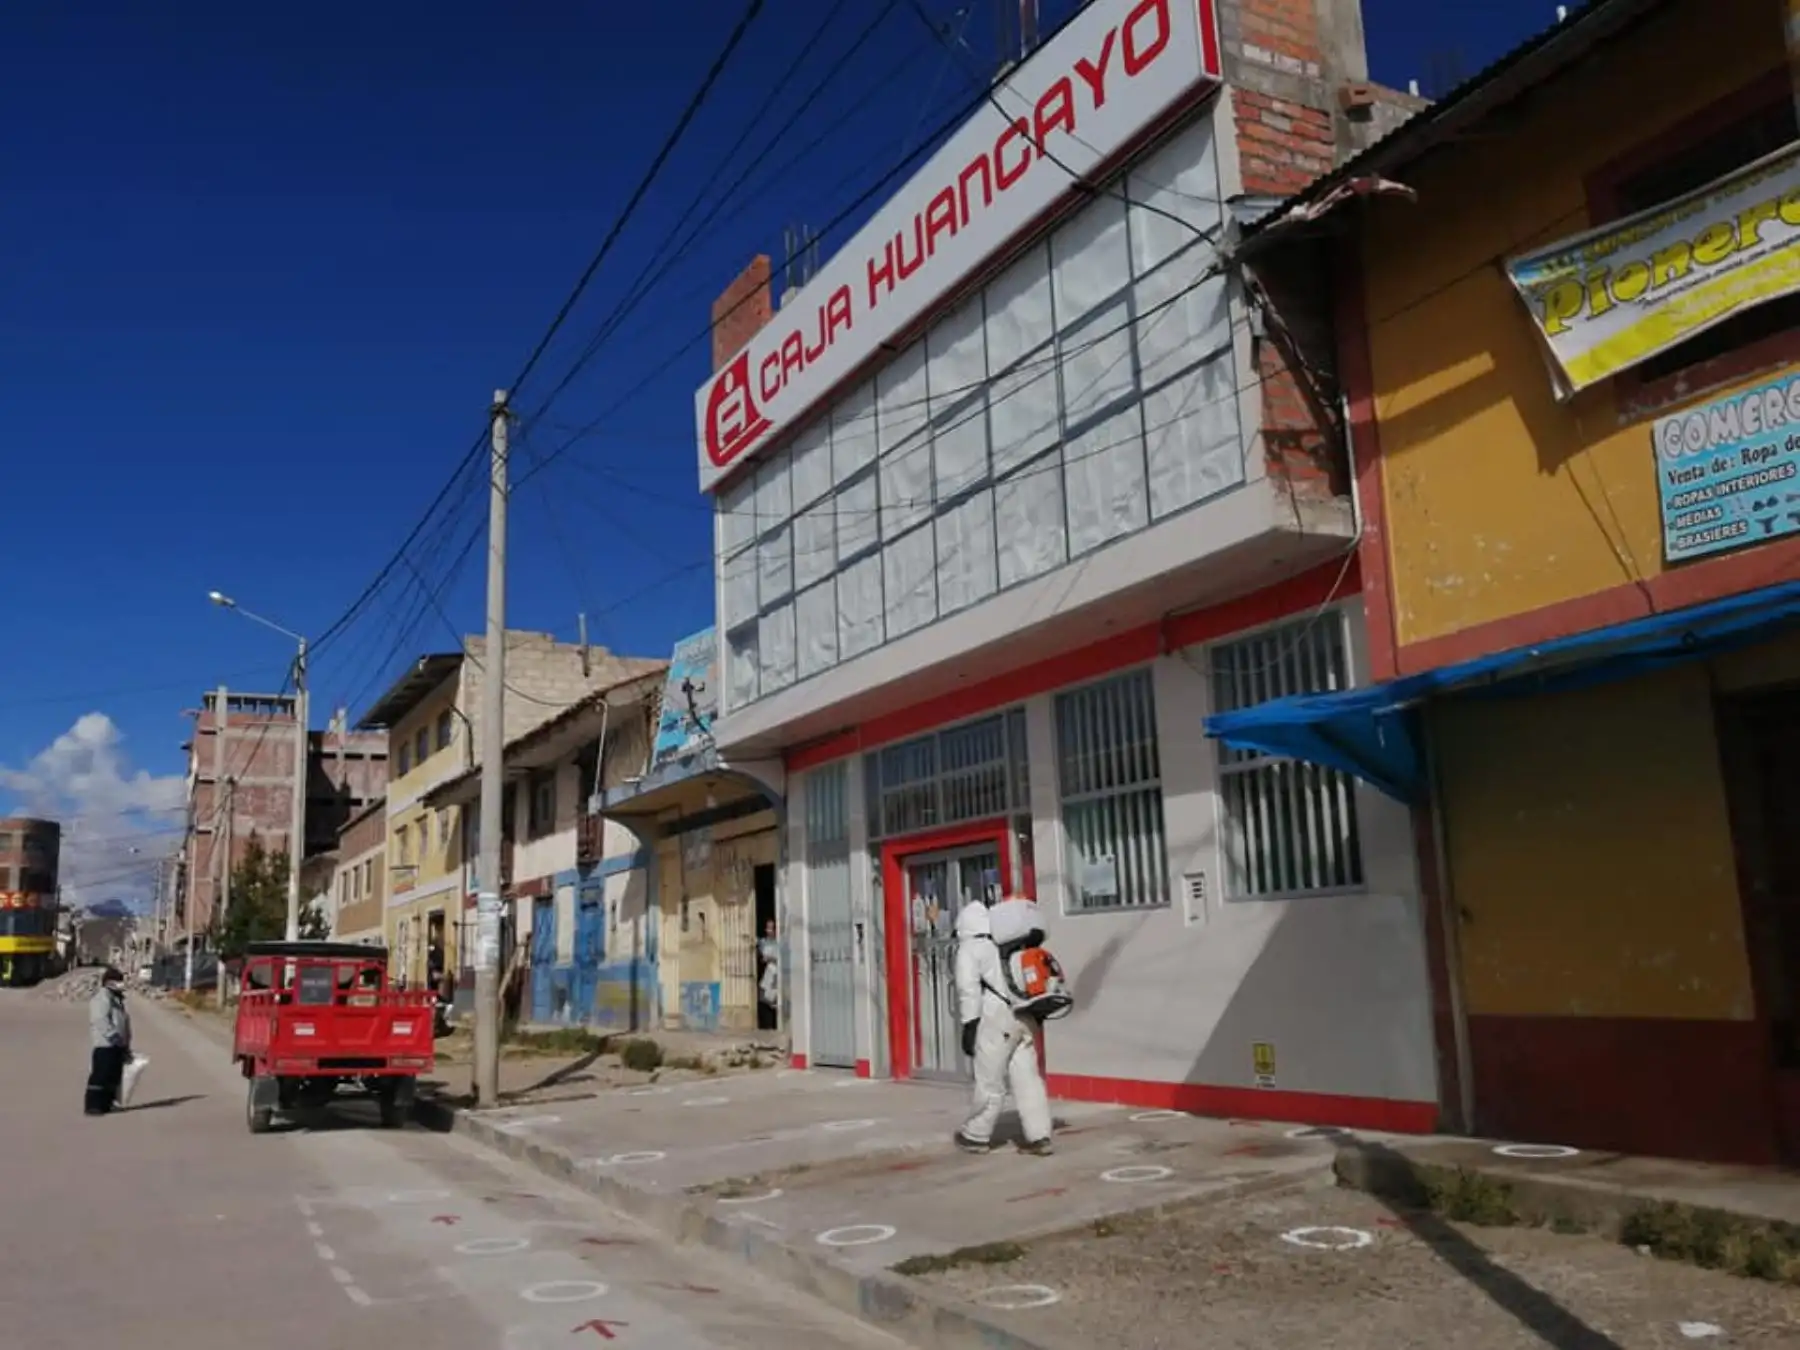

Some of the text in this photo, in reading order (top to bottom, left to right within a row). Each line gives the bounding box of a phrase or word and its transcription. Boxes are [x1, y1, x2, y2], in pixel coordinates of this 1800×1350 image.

[760, 0, 1170, 402] CAJA HUANCAYO
[1668, 466, 1704, 485] Venta
[1741, 444, 1777, 465] Ropa
[1715, 463, 1795, 497] INTERIORES
